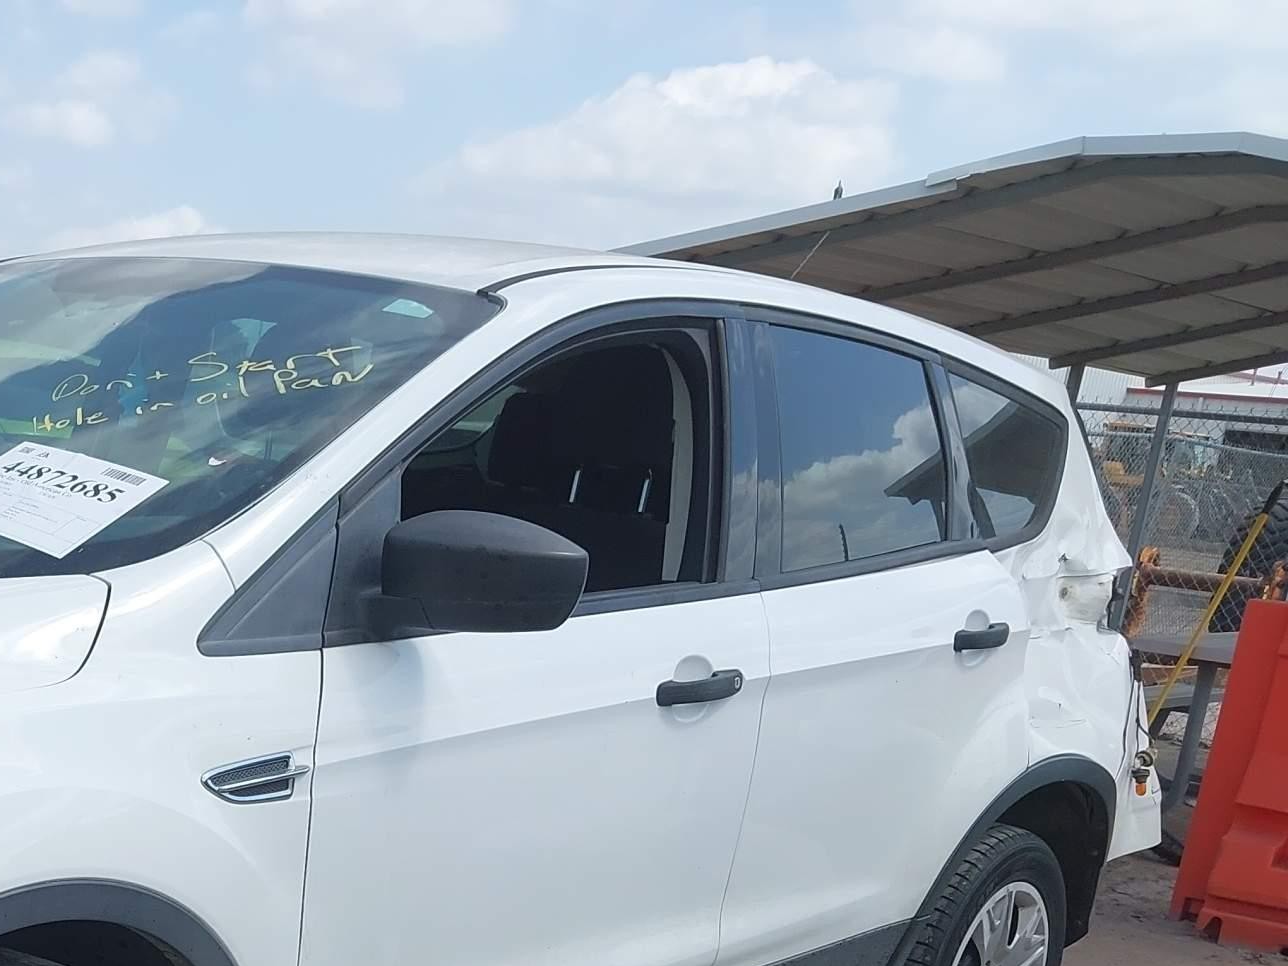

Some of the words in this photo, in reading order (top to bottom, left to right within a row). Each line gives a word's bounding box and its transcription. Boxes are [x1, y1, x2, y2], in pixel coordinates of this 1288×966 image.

[187, 346, 361, 382] Start
[32, 407, 110, 433] Hole
[135, 398, 174, 415] in
[196, 374, 249, 406] oil
[1, 461, 127, 503] 44872685
